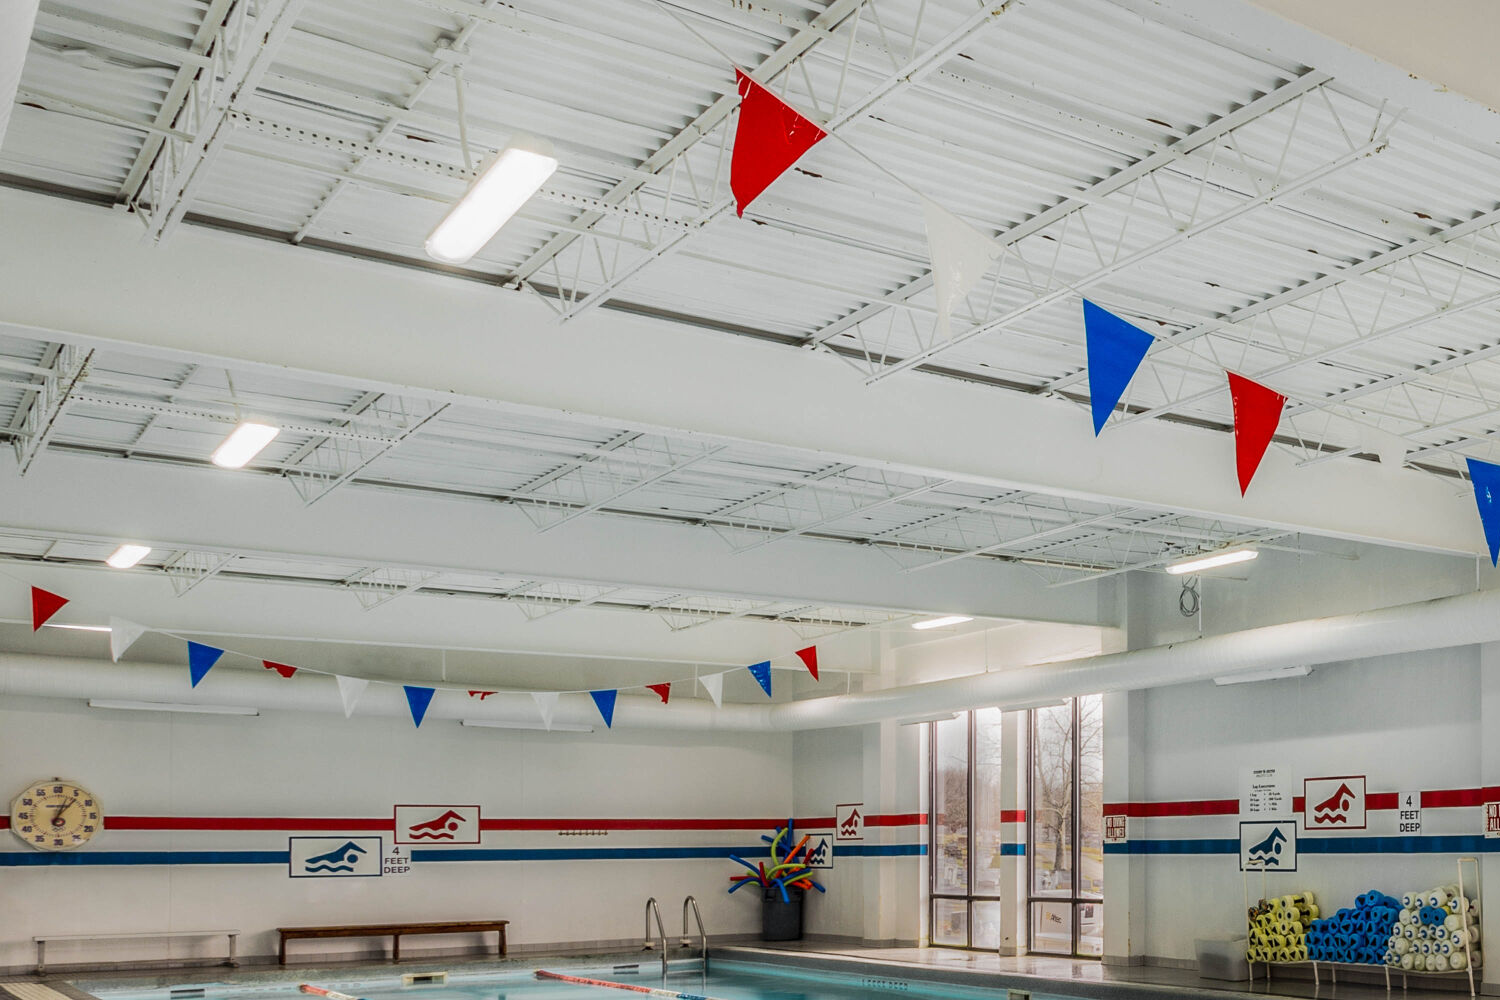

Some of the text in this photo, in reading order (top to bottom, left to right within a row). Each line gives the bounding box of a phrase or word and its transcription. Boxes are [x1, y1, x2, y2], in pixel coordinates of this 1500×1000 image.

[1405, 795, 1412, 807] 4
[1400, 810, 1419, 820] FEET
[1489, 804, 1497, 818] NO
[1400, 823, 1420, 832] DEEP
[392, 846, 400, 855] 4
[384, 857, 408, 865] FEET
